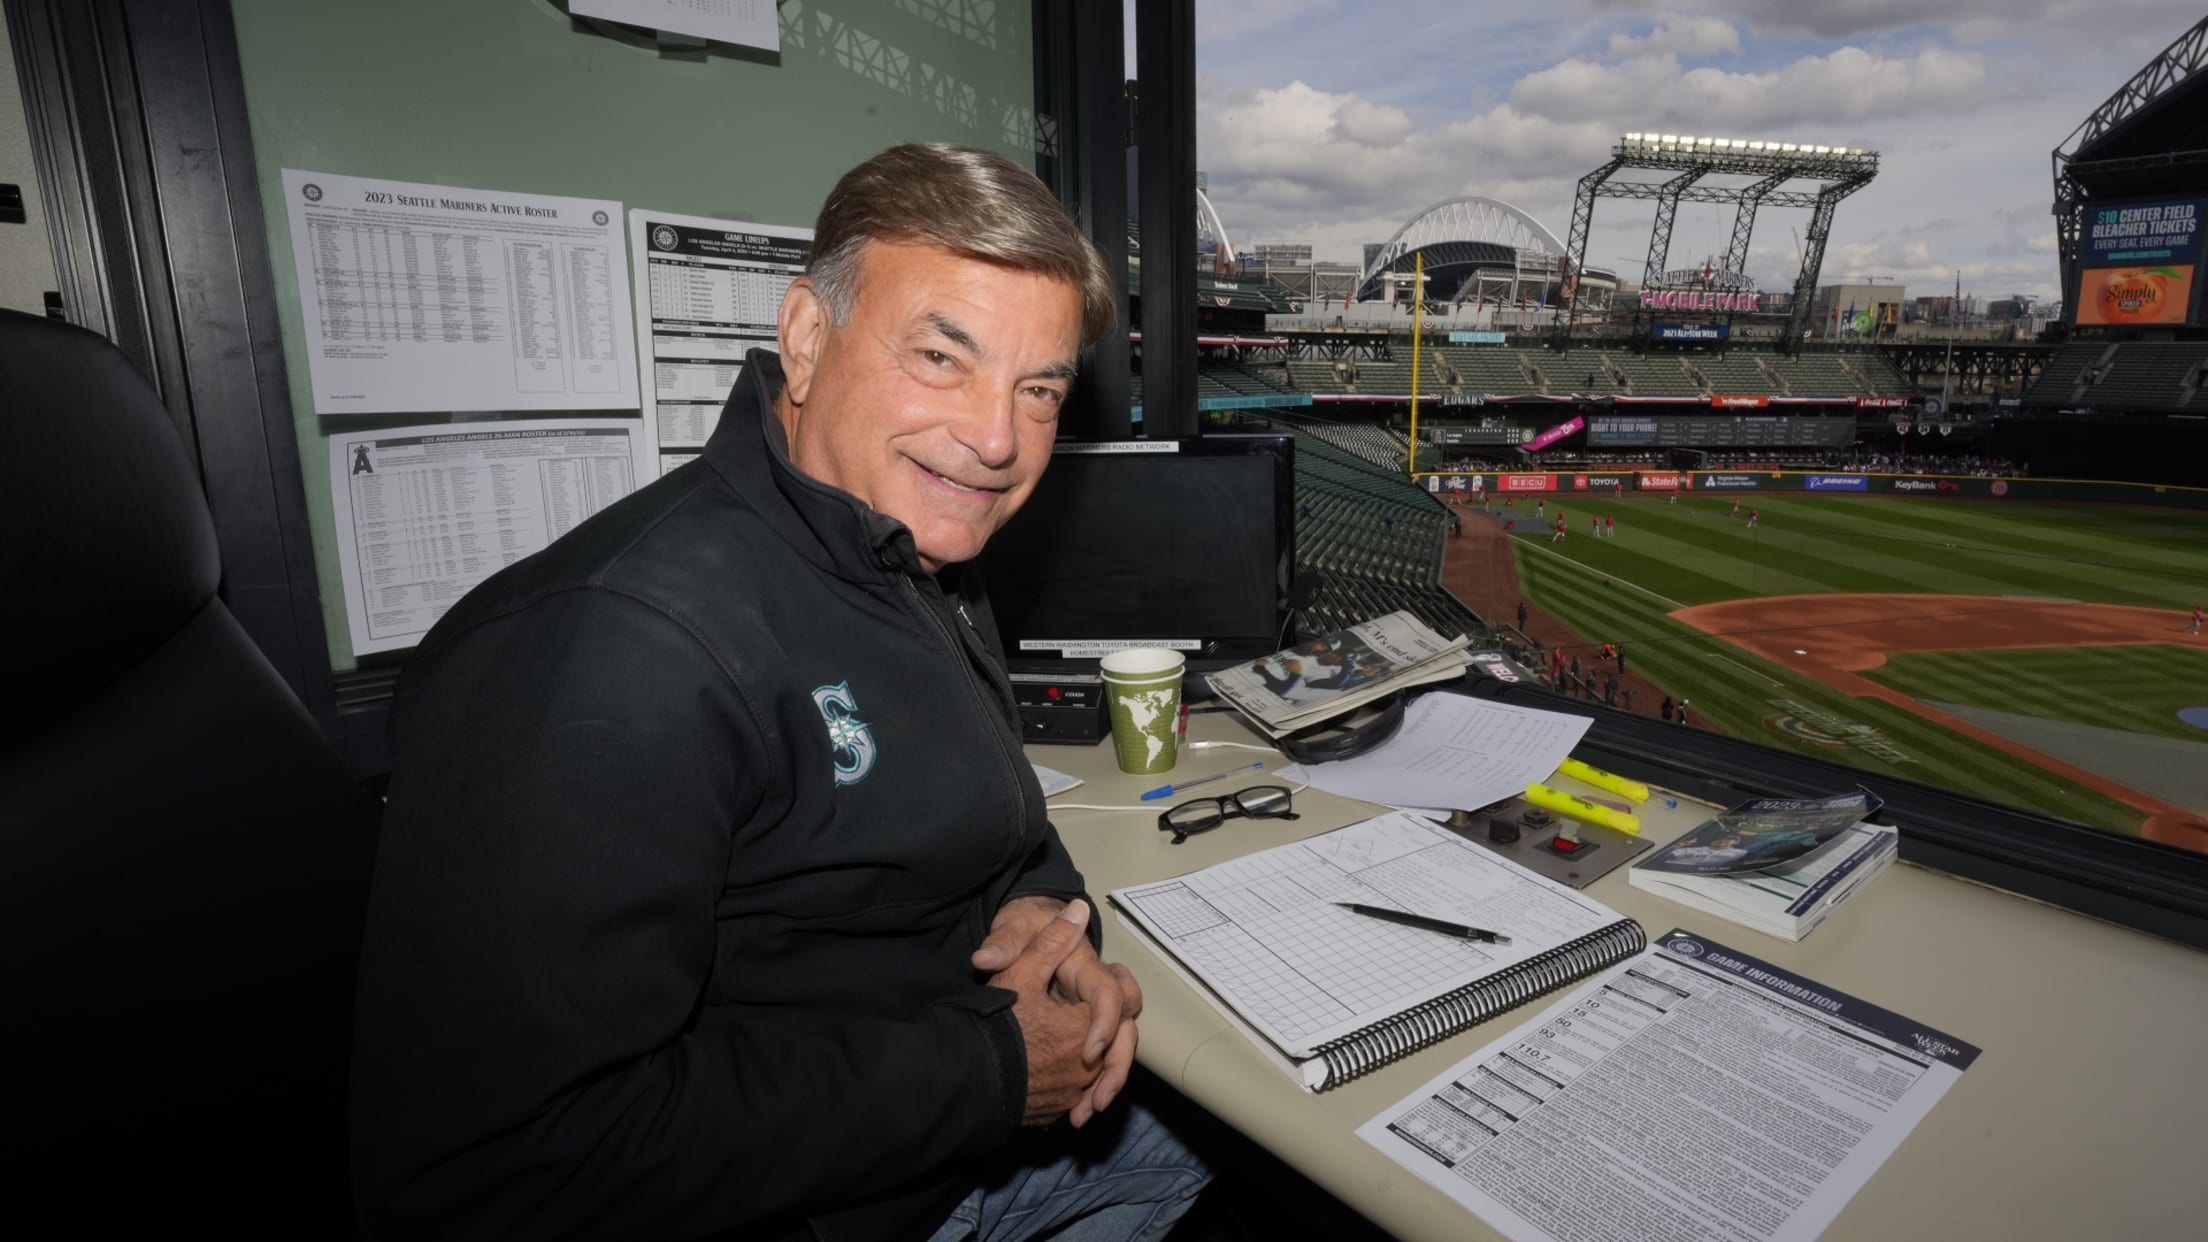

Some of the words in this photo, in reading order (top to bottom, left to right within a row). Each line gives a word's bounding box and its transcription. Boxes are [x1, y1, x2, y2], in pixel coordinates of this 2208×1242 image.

[364, 191, 393, 204] 2023
[397, 194, 437, 209] SEATTLE
[440, 199, 488, 213] MARINERS
[490, 203, 522, 216] ACTIVE
[525, 206, 558, 219] ROSTER
[2098, 210, 2118, 224] $10
[2119, 207, 2162, 223] CENTER
[2163, 204, 2195, 219] FIELD
[2093, 223, 2147, 238] BLEACHER
[2149, 218, 2197, 235] TICKETS
[2094, 238, 2118, 250] EVERY
[2118, 238, 2138, 249] SEAT,
[2140, 236, 2165, 247] EVERY
[2165, 234, 2190, 246] GAME
[1714, 270, 1755, 289] MARINERS
[2106, 284, 2156, 303] Simply
[1639, 290, 1713, 310] T-MOBILE
[1717, 293, 1761, 311] PARK
[1591, 423, 1609, 432] RIGHT
[1610, 423, 1618, 432] TO
[1135, 442, 1171, 450] NETWORK
[1511, 478, 1544, 488] BECU
[1589, 478, 1619, 486] TOYOTA
[1822, 477, 1861, 485] BOEING
[1895, 480, 1936, 491] KeyBank
[811, 680, 878, 788] S
[1706, 951, 1747, 974] GAME
[1745, 964, 1843, 1014] INFORMATION
[1585, 999, 1600, 1009] 10
[1572, 1007, 1586, 1018] 15
[1554, 1017, 1572, 1028] 50
[1538, 1028, 1556, 1039] 93
[1517, 1043, 1552, 1062] 110.7
